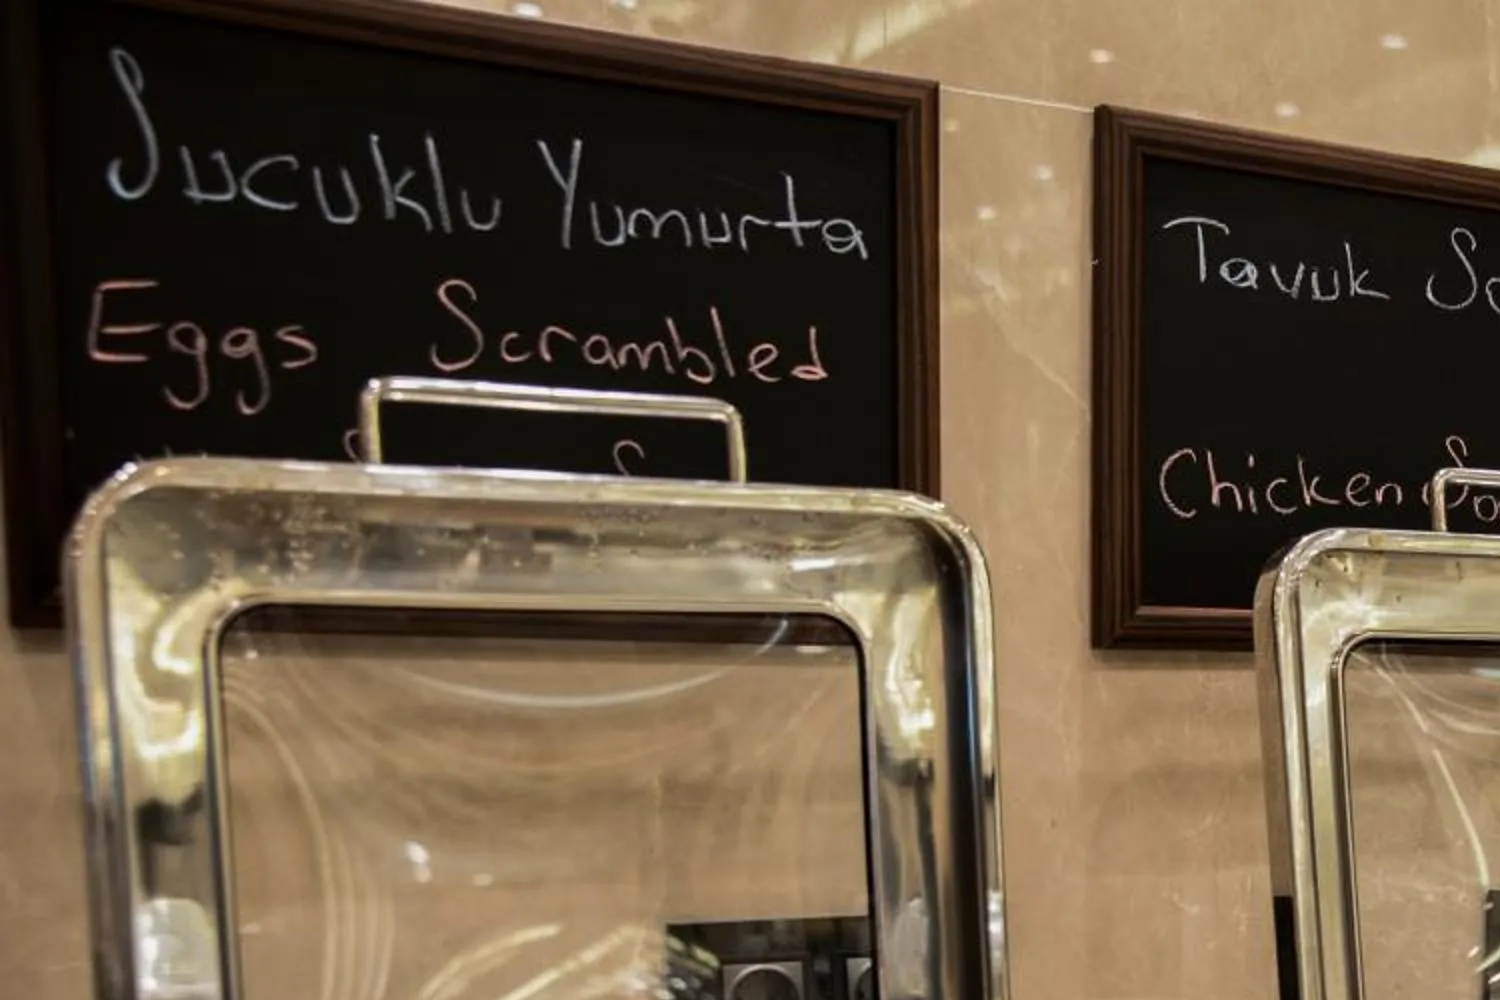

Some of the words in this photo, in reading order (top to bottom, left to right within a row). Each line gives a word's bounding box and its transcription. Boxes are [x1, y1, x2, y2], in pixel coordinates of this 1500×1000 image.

[106, 48, 502, 233] Sucuklu
[537, 136, 869, 261] Yumurta
[1163, 216, 1390, 301] Tavuk
[87, 279, 319, 415] Eggs
[431, 279, 829, 384] Scrambled
[1158, 447, 1403, 520] Chicken
